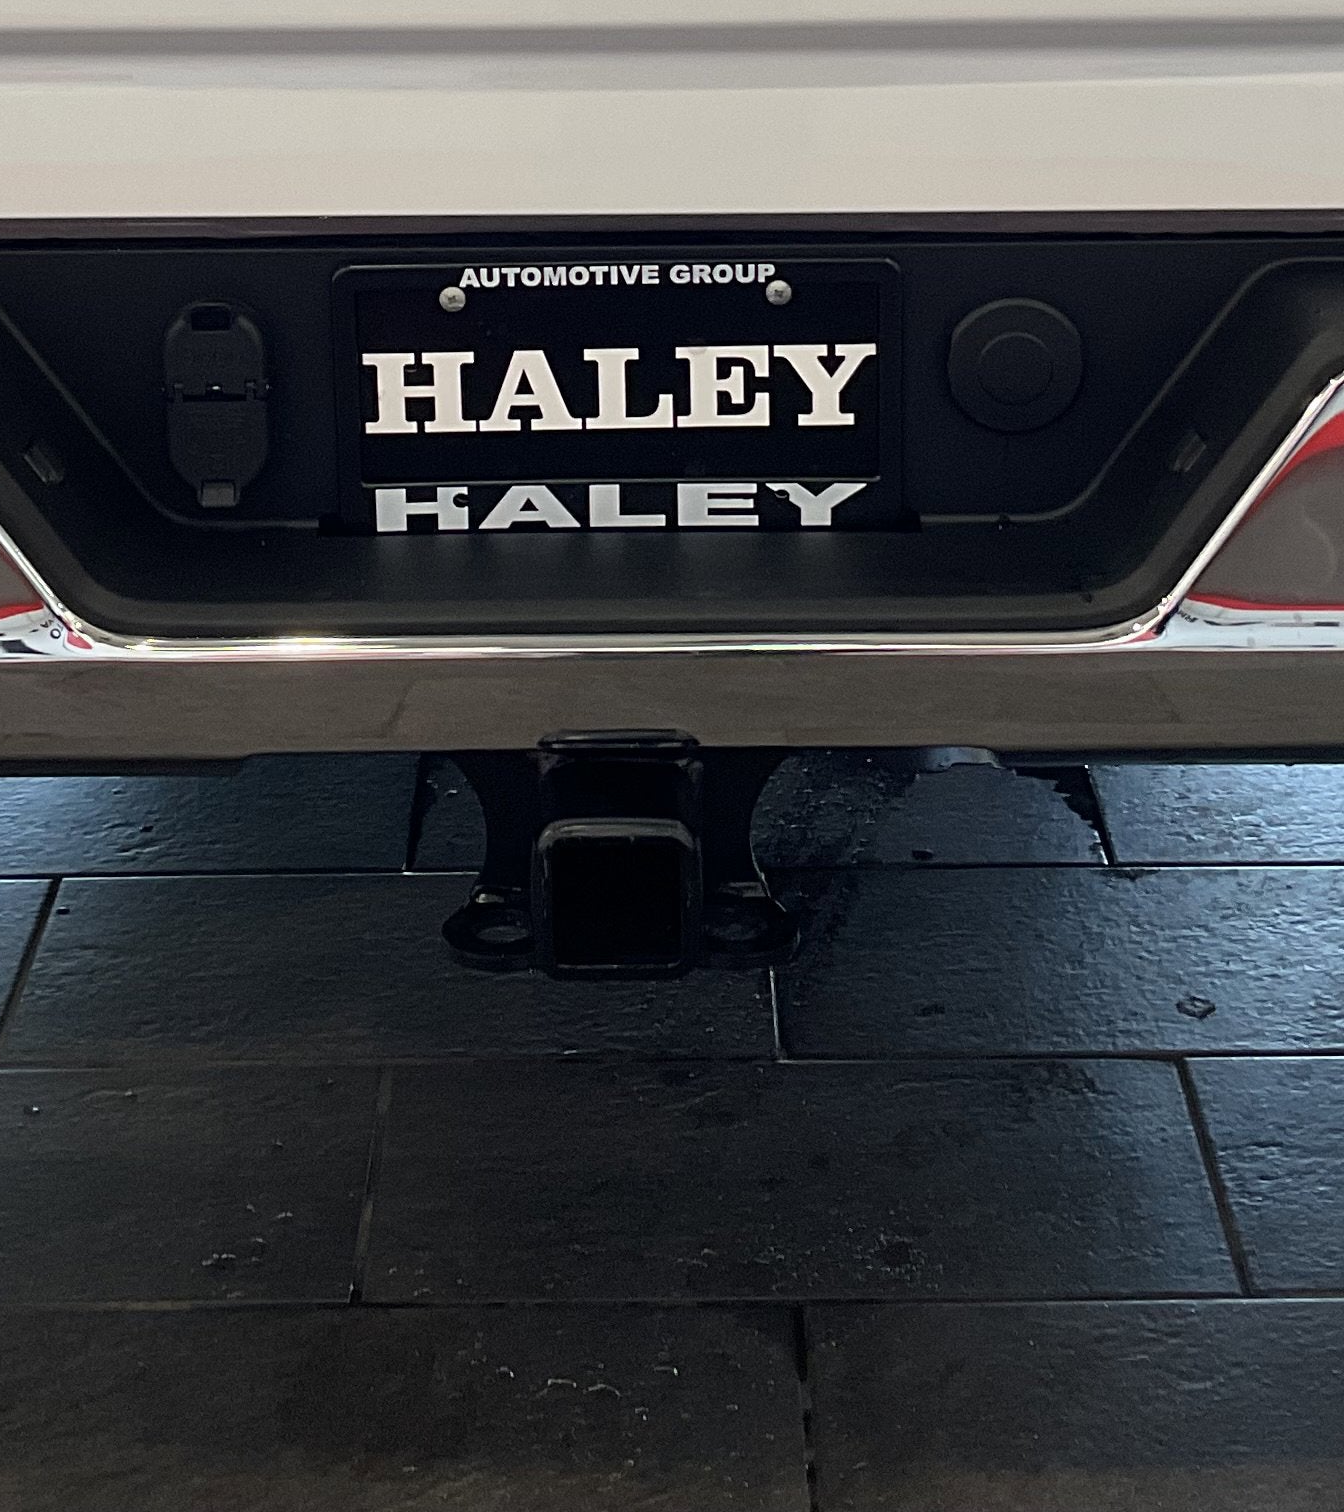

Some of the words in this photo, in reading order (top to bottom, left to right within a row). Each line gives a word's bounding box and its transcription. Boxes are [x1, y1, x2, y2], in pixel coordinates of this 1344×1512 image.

[459, 264, 660, 288] AUTOMOTIVE
[669, 263, 776, 285] GROUP
[361, 342, 877, 435] HALEY
[374, 482, 868, 532] HALEY
